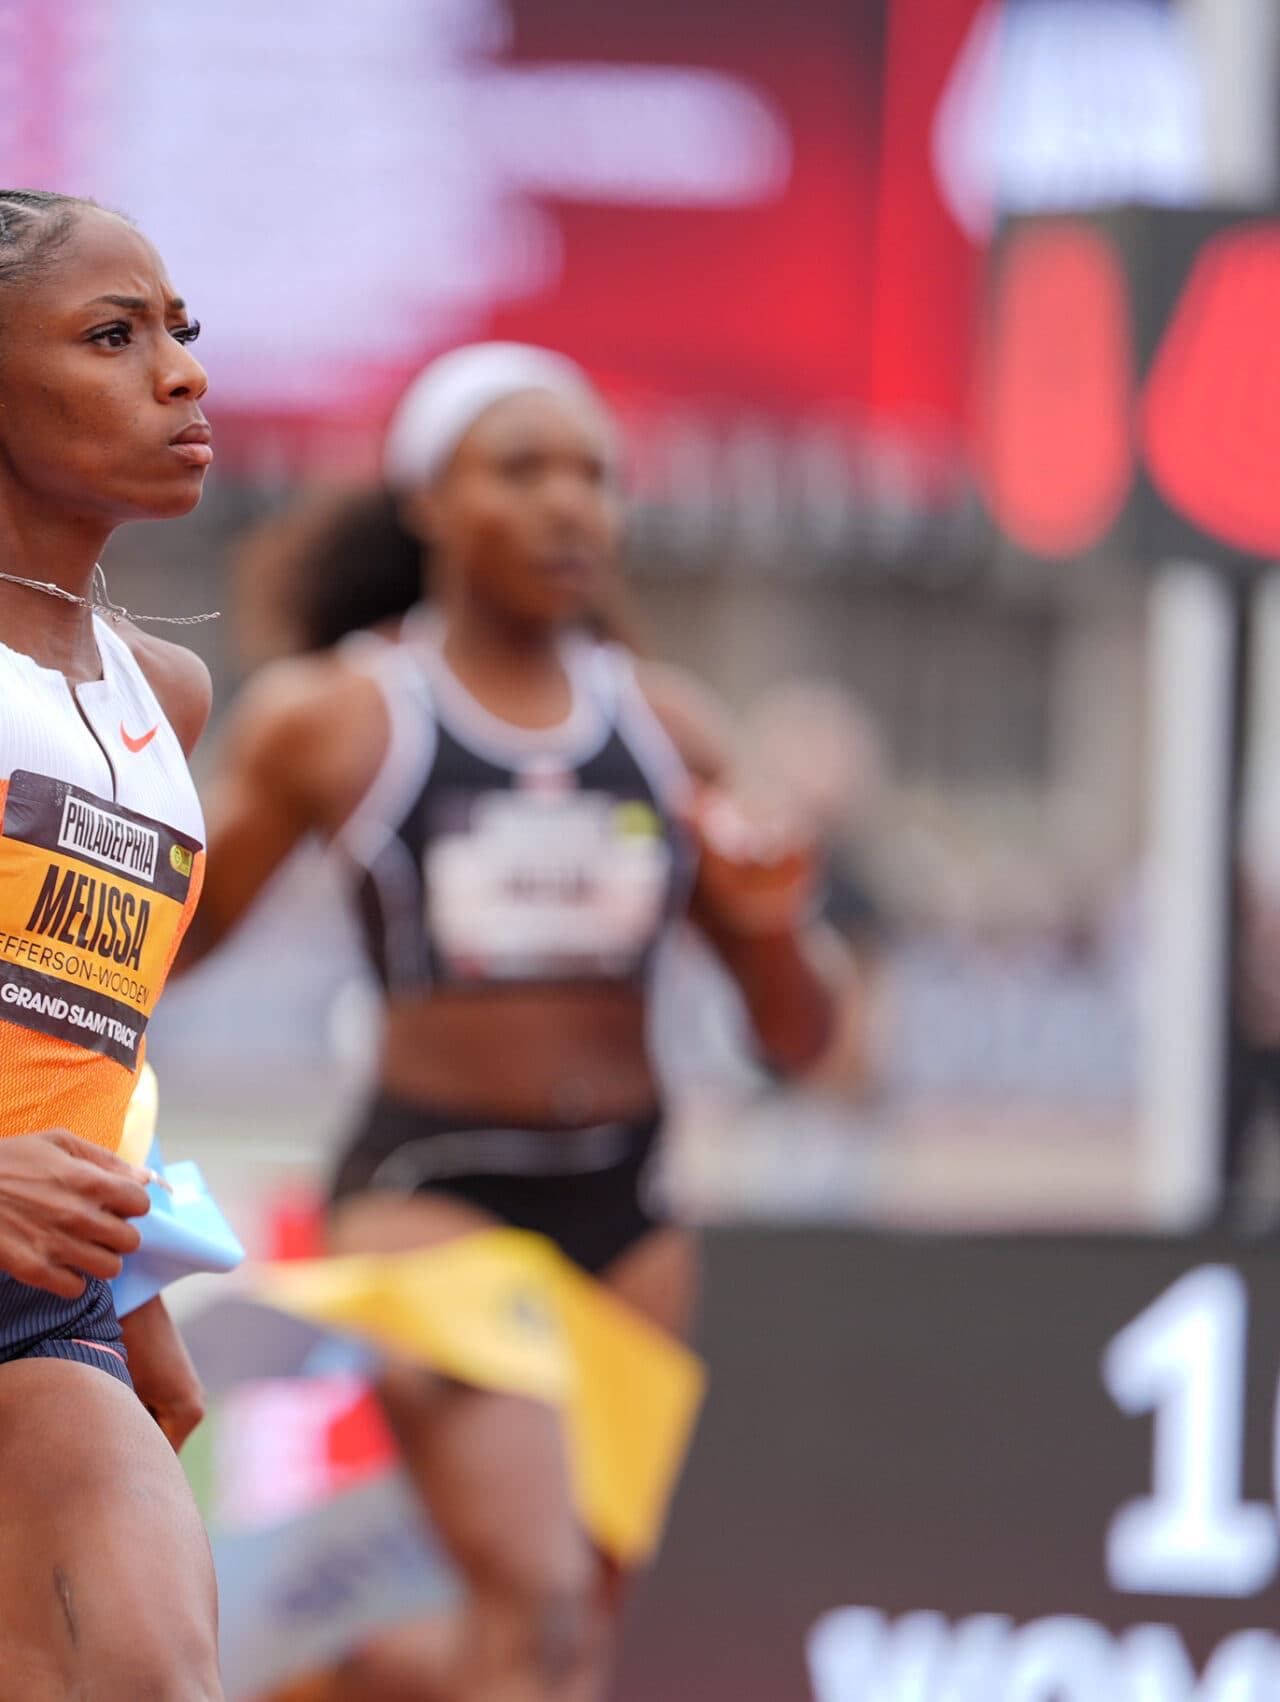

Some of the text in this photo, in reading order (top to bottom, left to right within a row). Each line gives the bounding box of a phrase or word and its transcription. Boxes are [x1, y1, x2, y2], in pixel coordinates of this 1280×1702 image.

[62, 802, 155, 875] PHILADELPHIA
[25, 864, 150, 971] MELISSA
[0, 983, 137, 1050] GRAND SLAM TRACK
[1100, 1262, 1280, 1598] 1
